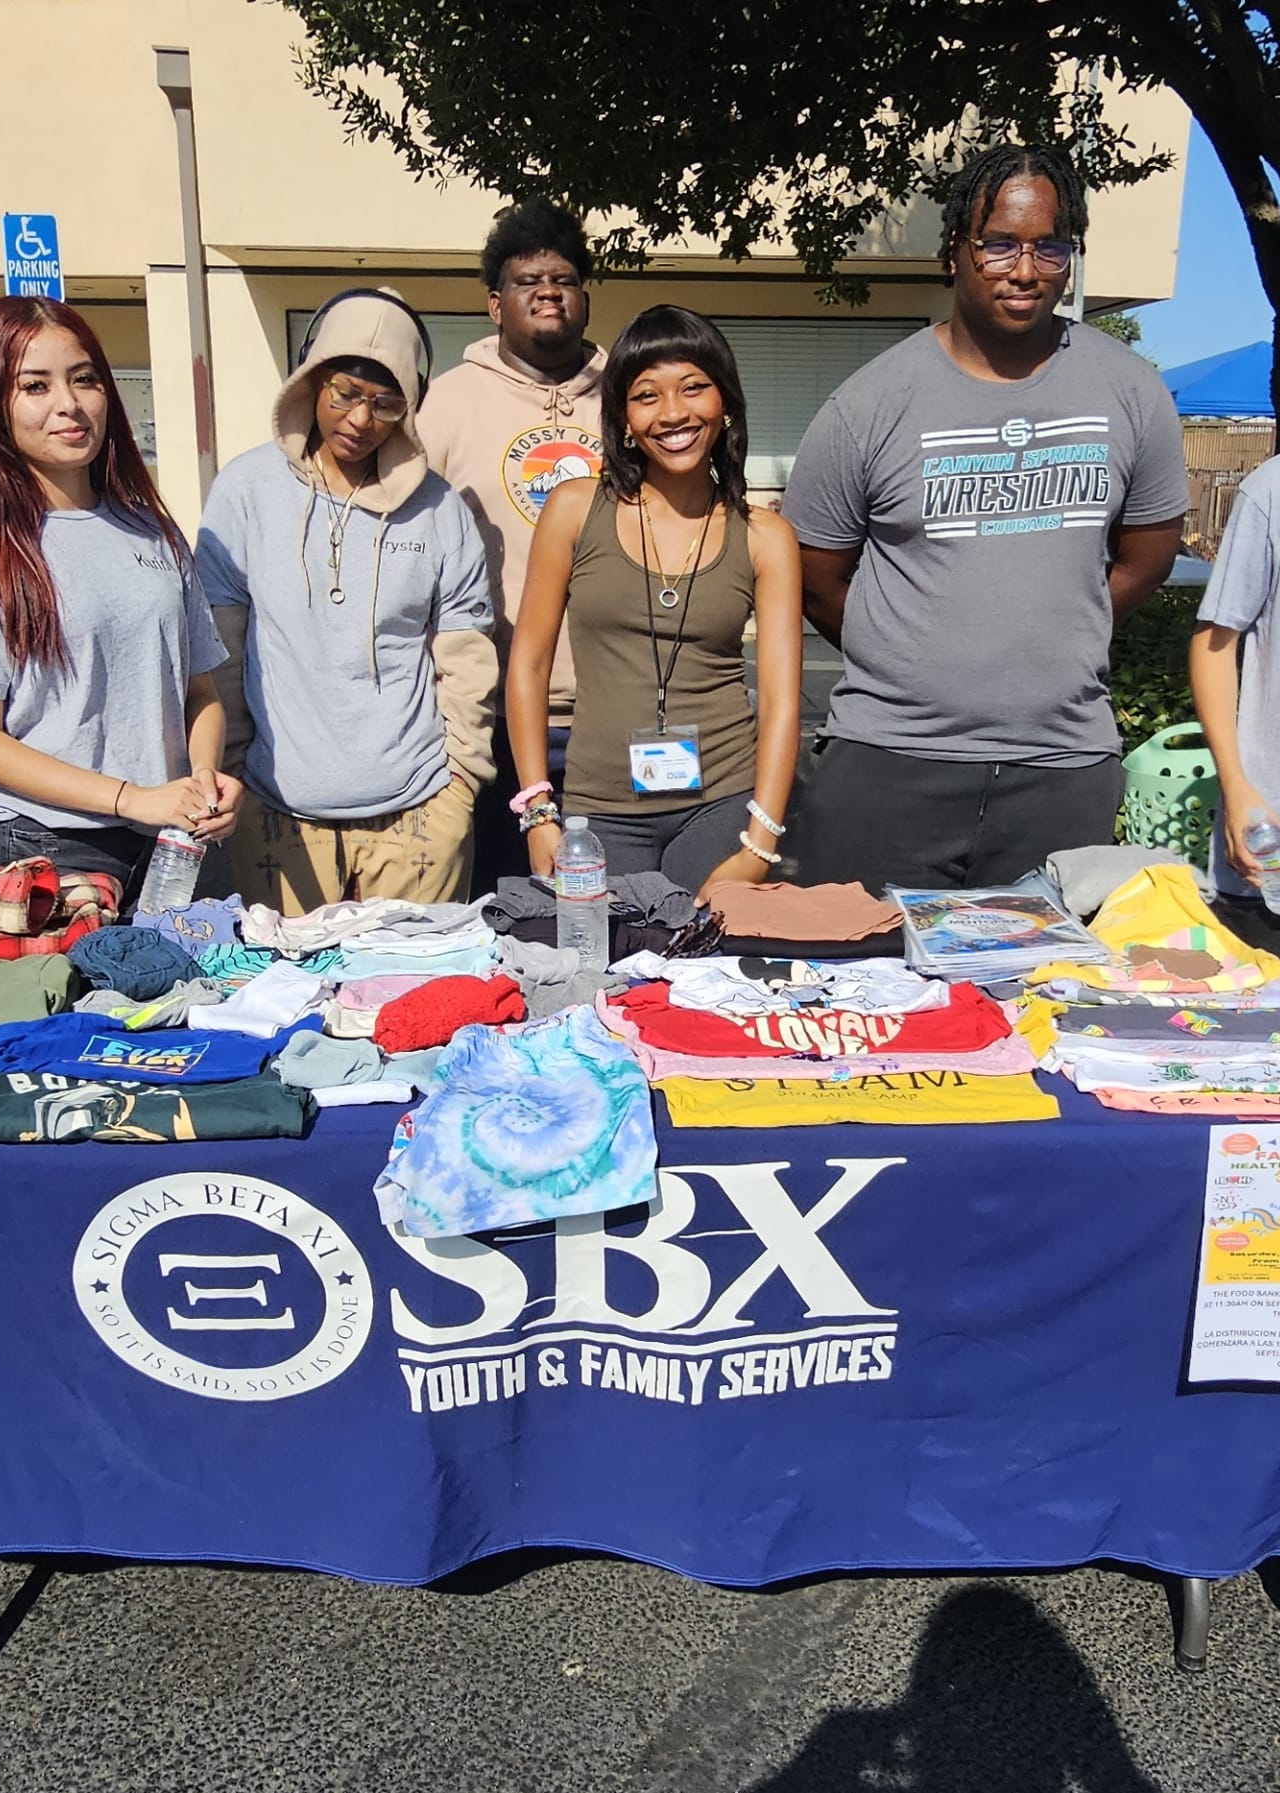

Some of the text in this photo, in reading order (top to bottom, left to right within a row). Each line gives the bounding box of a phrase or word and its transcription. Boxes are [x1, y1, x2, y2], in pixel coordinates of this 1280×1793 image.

[7, 260, 60, 278] PARKING
[20, 280, 50, 297] ONLY
[508, 428, 566, 462] MOSSY
[922, 444, 1108, 478] CANYON SPRINGS
[922, 464, 1110, 519] WRESTLING
[980, 513, 1062, 536] COUGARS
[91, 1183, 340, 1266] SIGMA BETA XI
[385, 1157, 907, 1336] SBX
[94, 1296, 359, 1394] SO IT IS SAID, SO IT IS DONE
[1196, 1340, 1248, 1348] COMENZARA
[399, 1335, 897, 1413] YOUTH & FAMILY SERVICES
